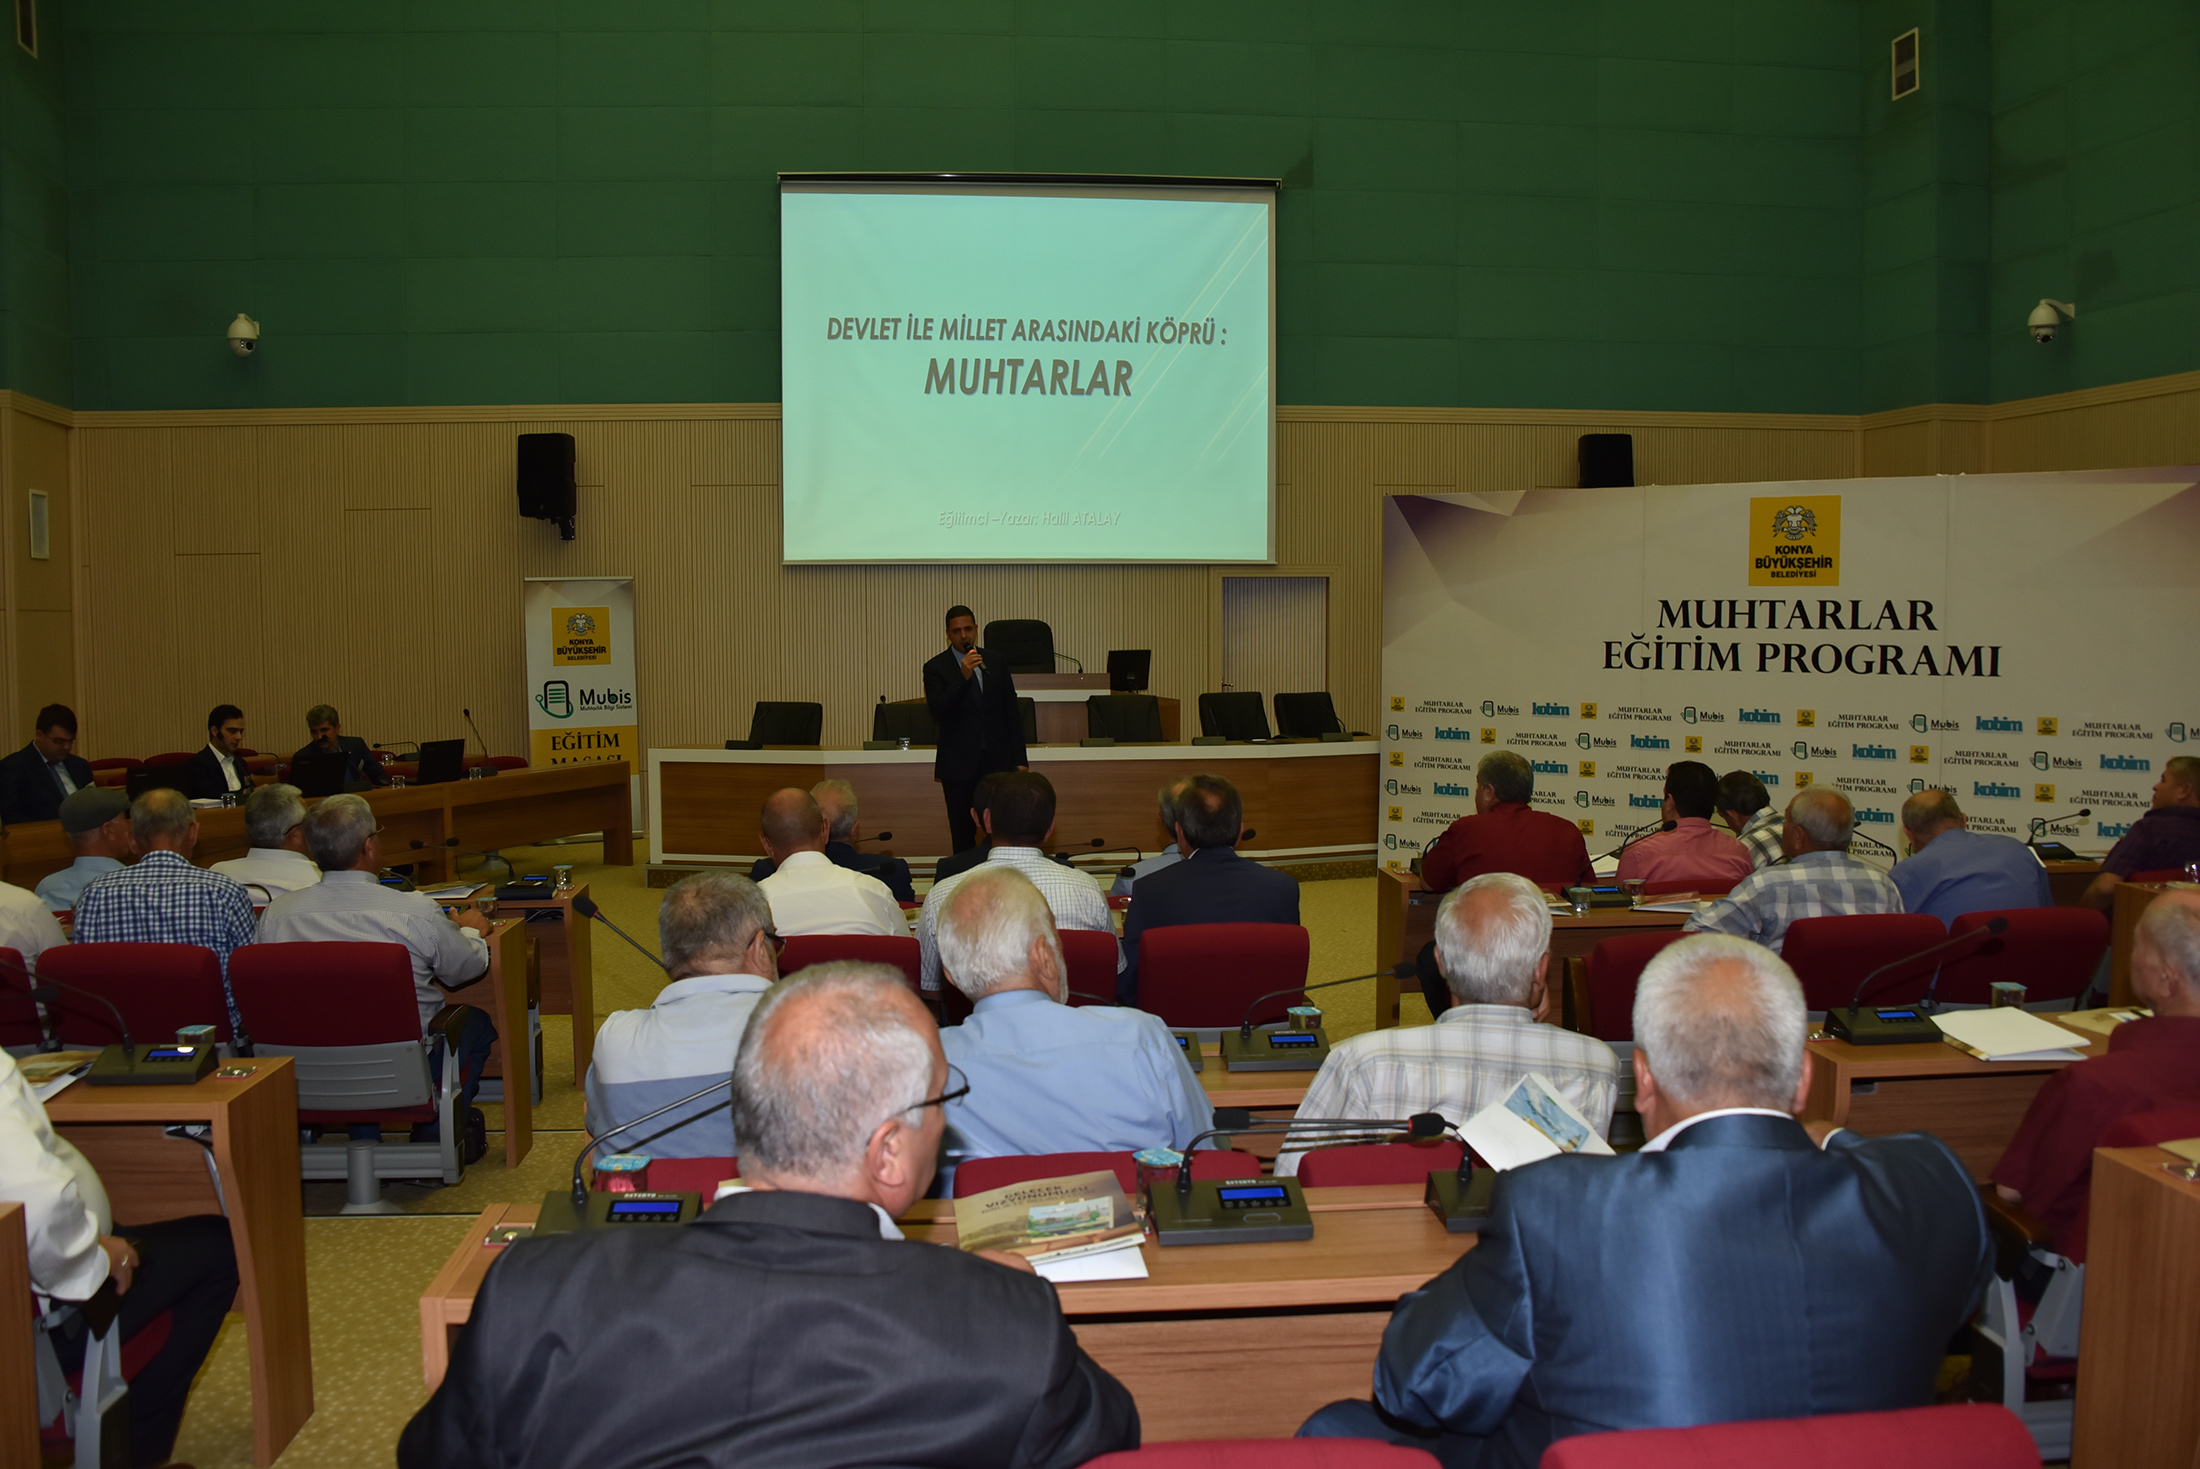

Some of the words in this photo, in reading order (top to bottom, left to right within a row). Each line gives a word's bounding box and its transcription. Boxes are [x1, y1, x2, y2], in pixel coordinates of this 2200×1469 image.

[827, 318, 901, 340] DEVLET
[906, 313, 933, 340] İLE
[939, 314, 1007, 341] MİLLET
[1012, 316, 1140, 343] ARASINDAKİ
[1146, 316, 1216, 345] KÖPRÜ
[924, 358, 1133, 396] MUHTARLAR
[938, 511, 989, 529] Eğitimci
[1042, 511, 1069, 526] Halil
[1072, 511, 1121, 526] ATALAY
[1775, 545, 1813, 555] KONYA
[1755, 554, 1833, 571] BÜYÜKŞEHİR
[1770, 569, 1817, 578] BELEDİYESİ
[1656, 600, 1938, 631] MUHTARLAR
[557, 645, 606, 655] BÜYÜKŞEHİR
[1602, 632, 1742, 672] EĞİTİM
[1756, 643, 2002, 677] PROGRAMI
[580, 688, 632, 706] Mubis
[1532, 702, 1570, 716] kobim
[1739, 708, 1781, 723] kobim
[1976, 716, 2023, 732] kobim
[551, 731, 620, 751] EĞİTİM
[1435, 726, 1470, 741] kobim
[1630, 734, 1670, 749] kobim
[1852, 744, 1897, 760] kobim
[2100, 754, 2150, 771] kobim
[1434, 782, 1469, 796] kobim
[1974, 782, 2020, 798] kobim
[1855, 808, 1895, 823] obim
